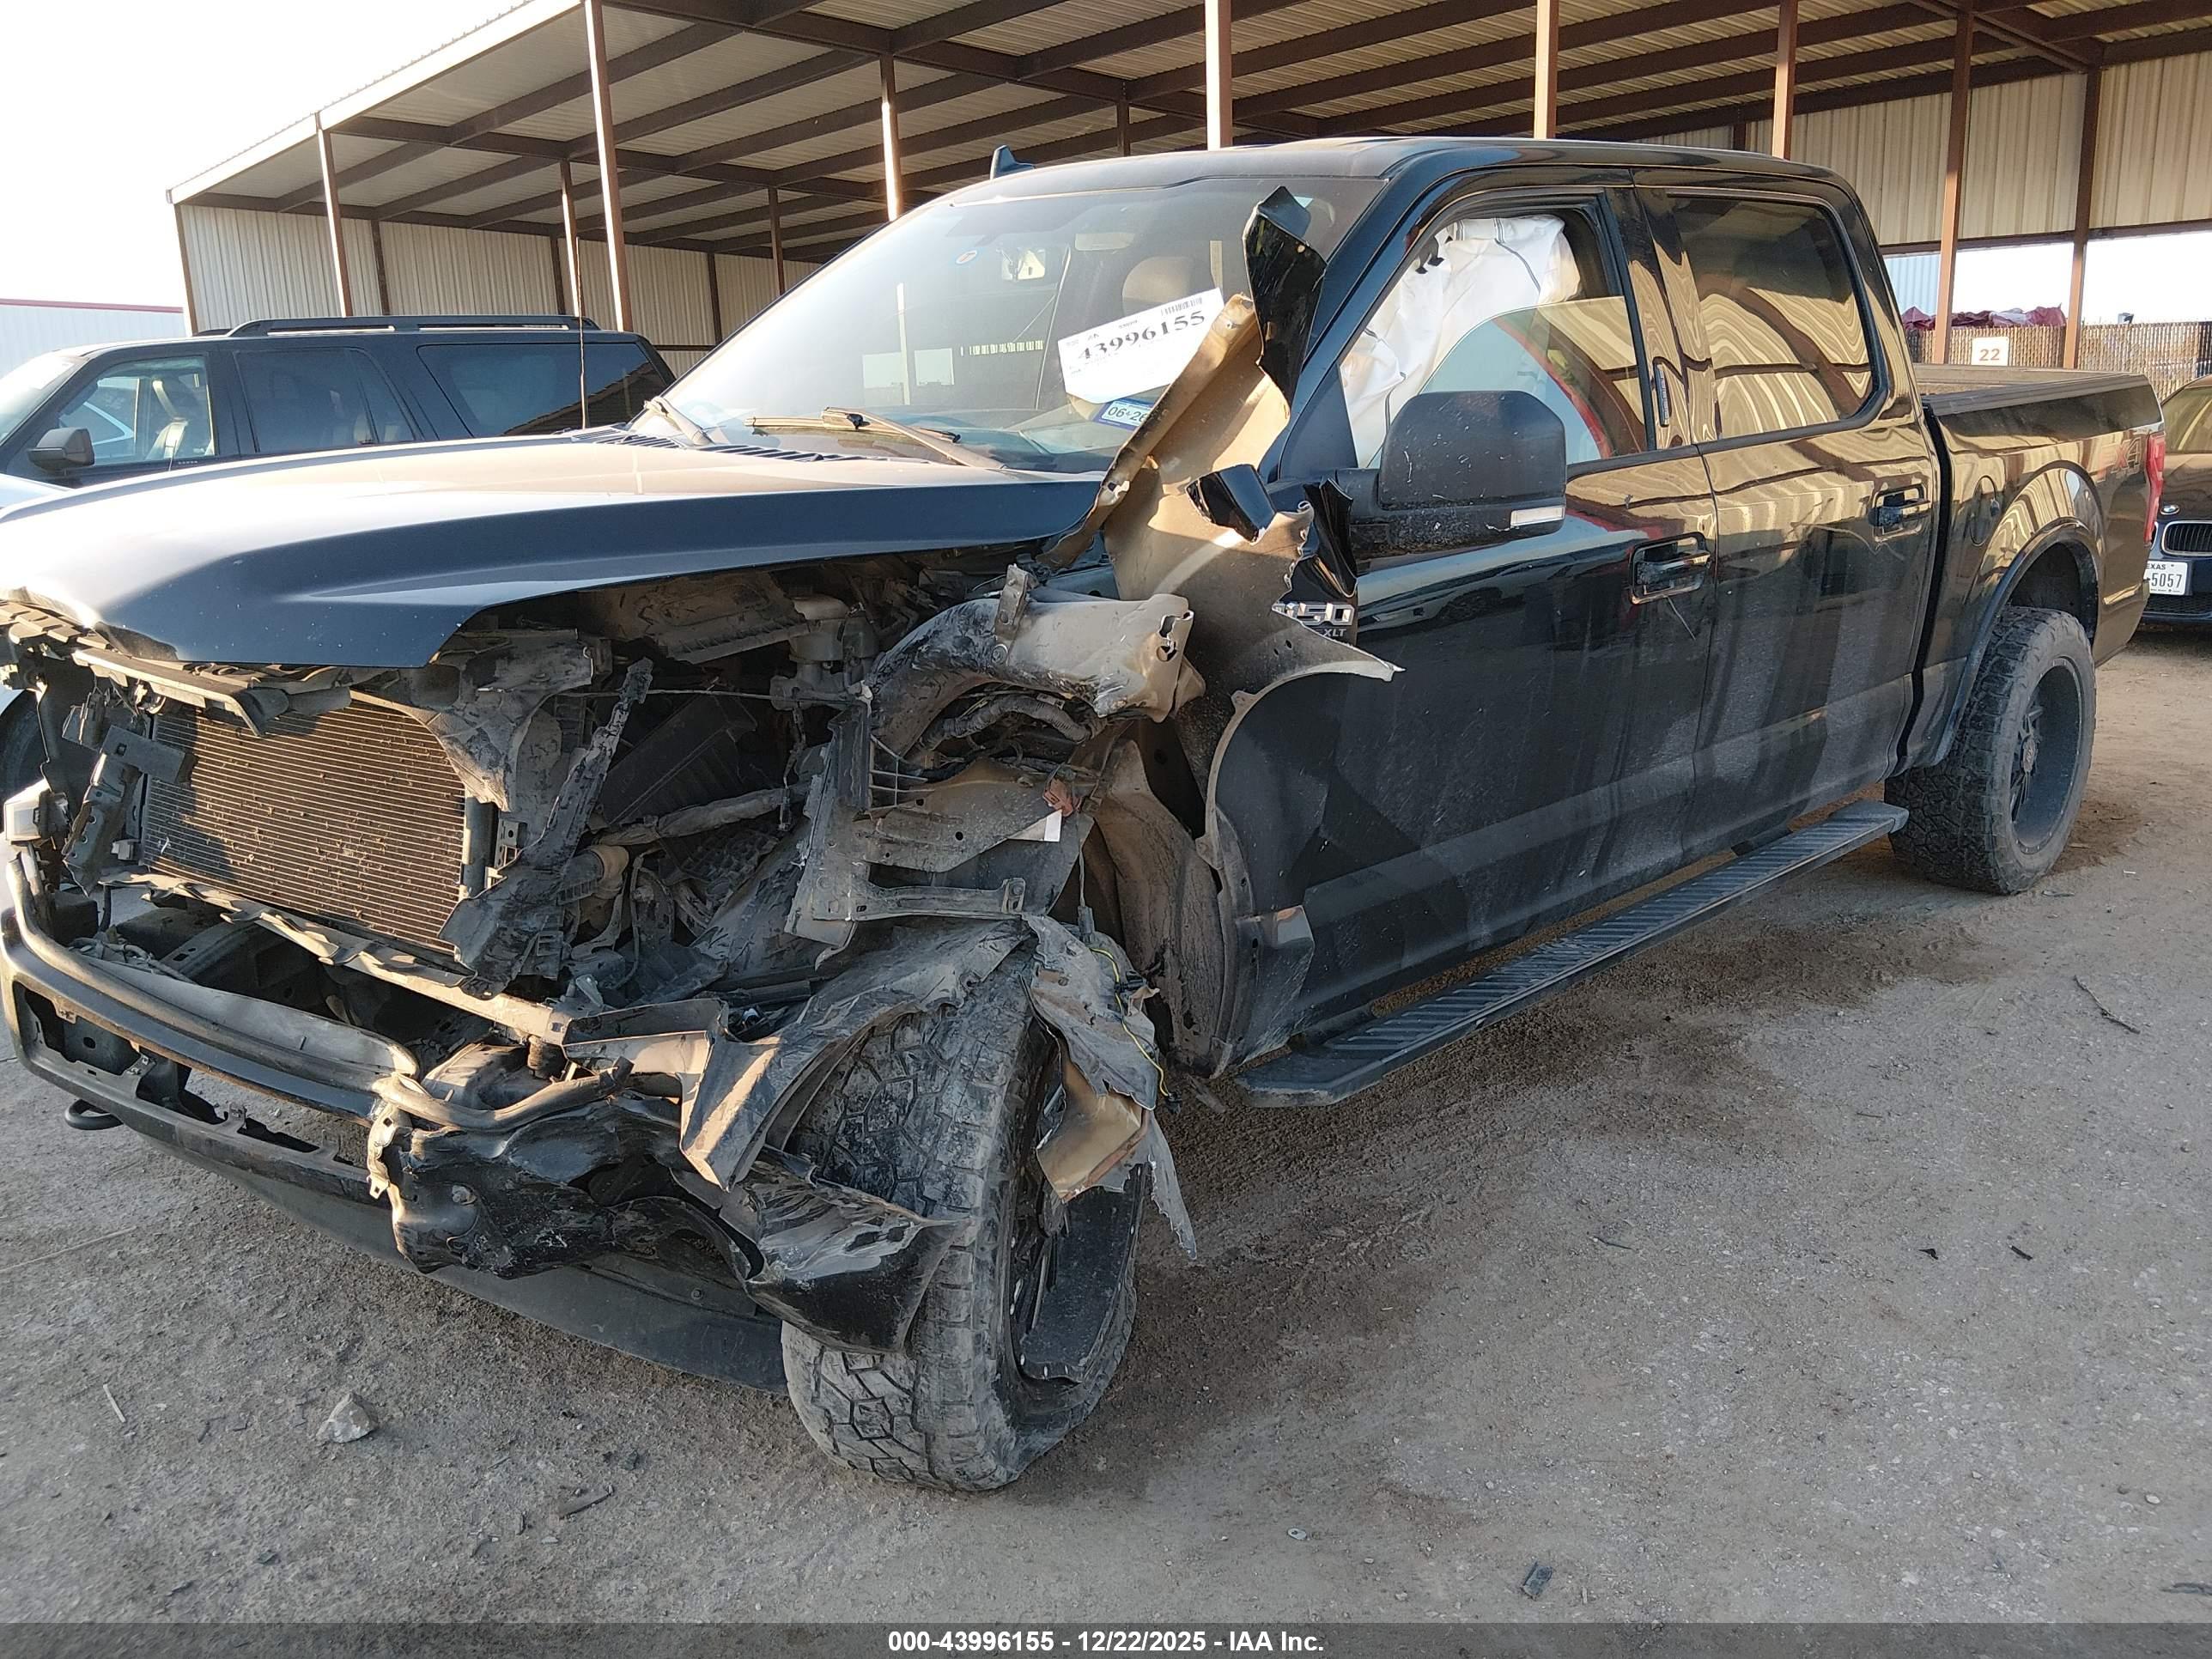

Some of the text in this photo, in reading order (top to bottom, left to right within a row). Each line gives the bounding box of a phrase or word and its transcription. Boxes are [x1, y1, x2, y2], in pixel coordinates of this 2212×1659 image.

[1078, 310, 1206, 360] 43996155
[1979, 348, 2000, 362] 22
[1108, 406, 1127, 418] 06
[2151, 573, 2183, 588] 5057
[1273, 601, 1355, 626] 150
[1323, 629, 1347, 637] XLT
